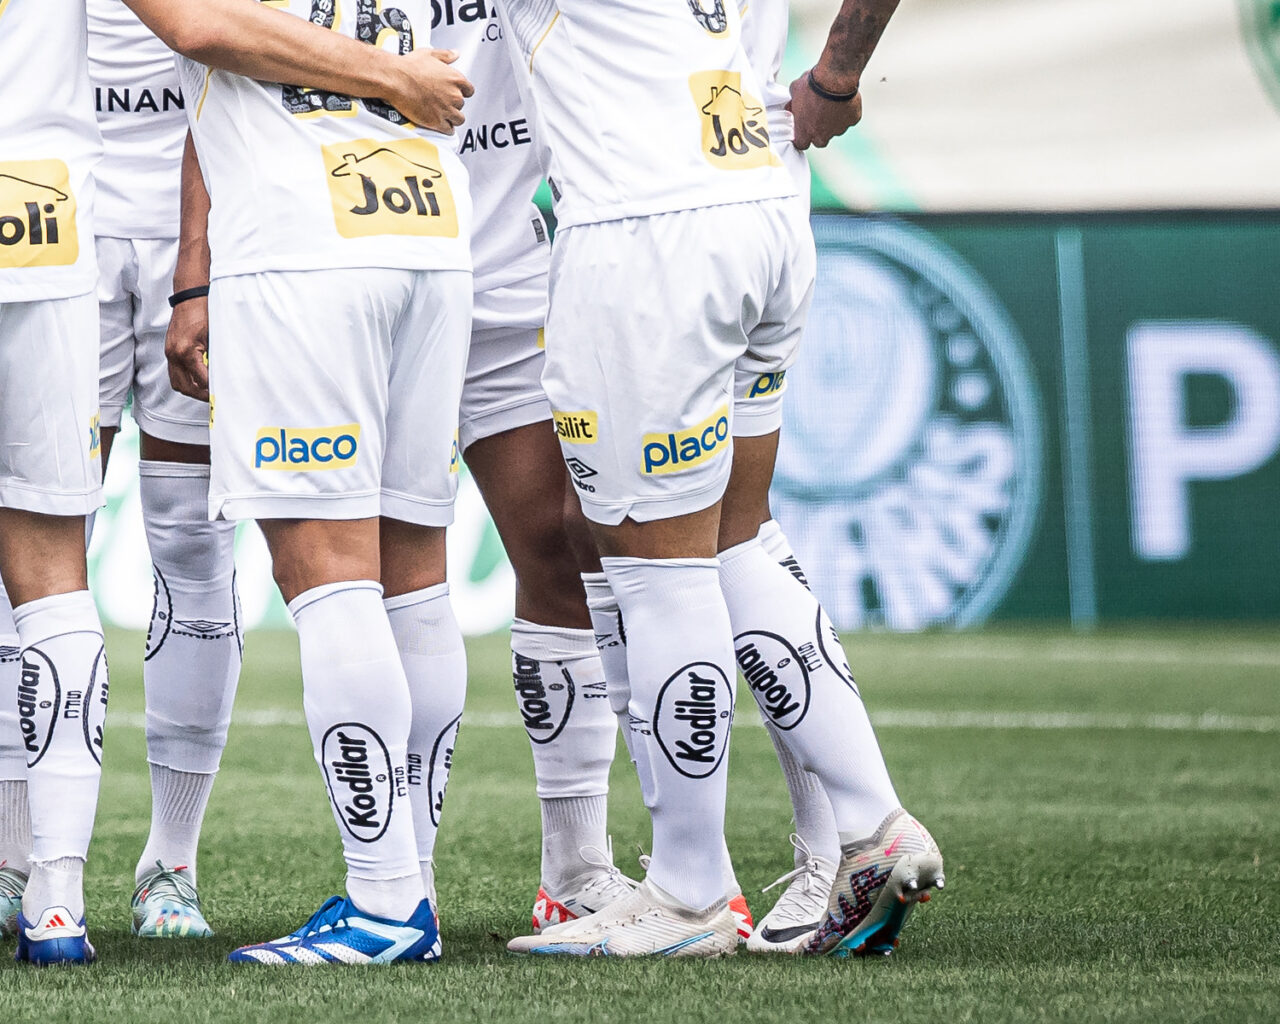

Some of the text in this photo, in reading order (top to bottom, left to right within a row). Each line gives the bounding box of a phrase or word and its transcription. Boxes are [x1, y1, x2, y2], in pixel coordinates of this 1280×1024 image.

[95, 86, 185, 113] INAN
[350, 175, 441, 217] Joli
[254, 427, 358, 468] placo
[643, 414, 729, 474] placo
[673, 671, 717, 764] Kodilar
[332, 731, 381, 829] Kodilar
